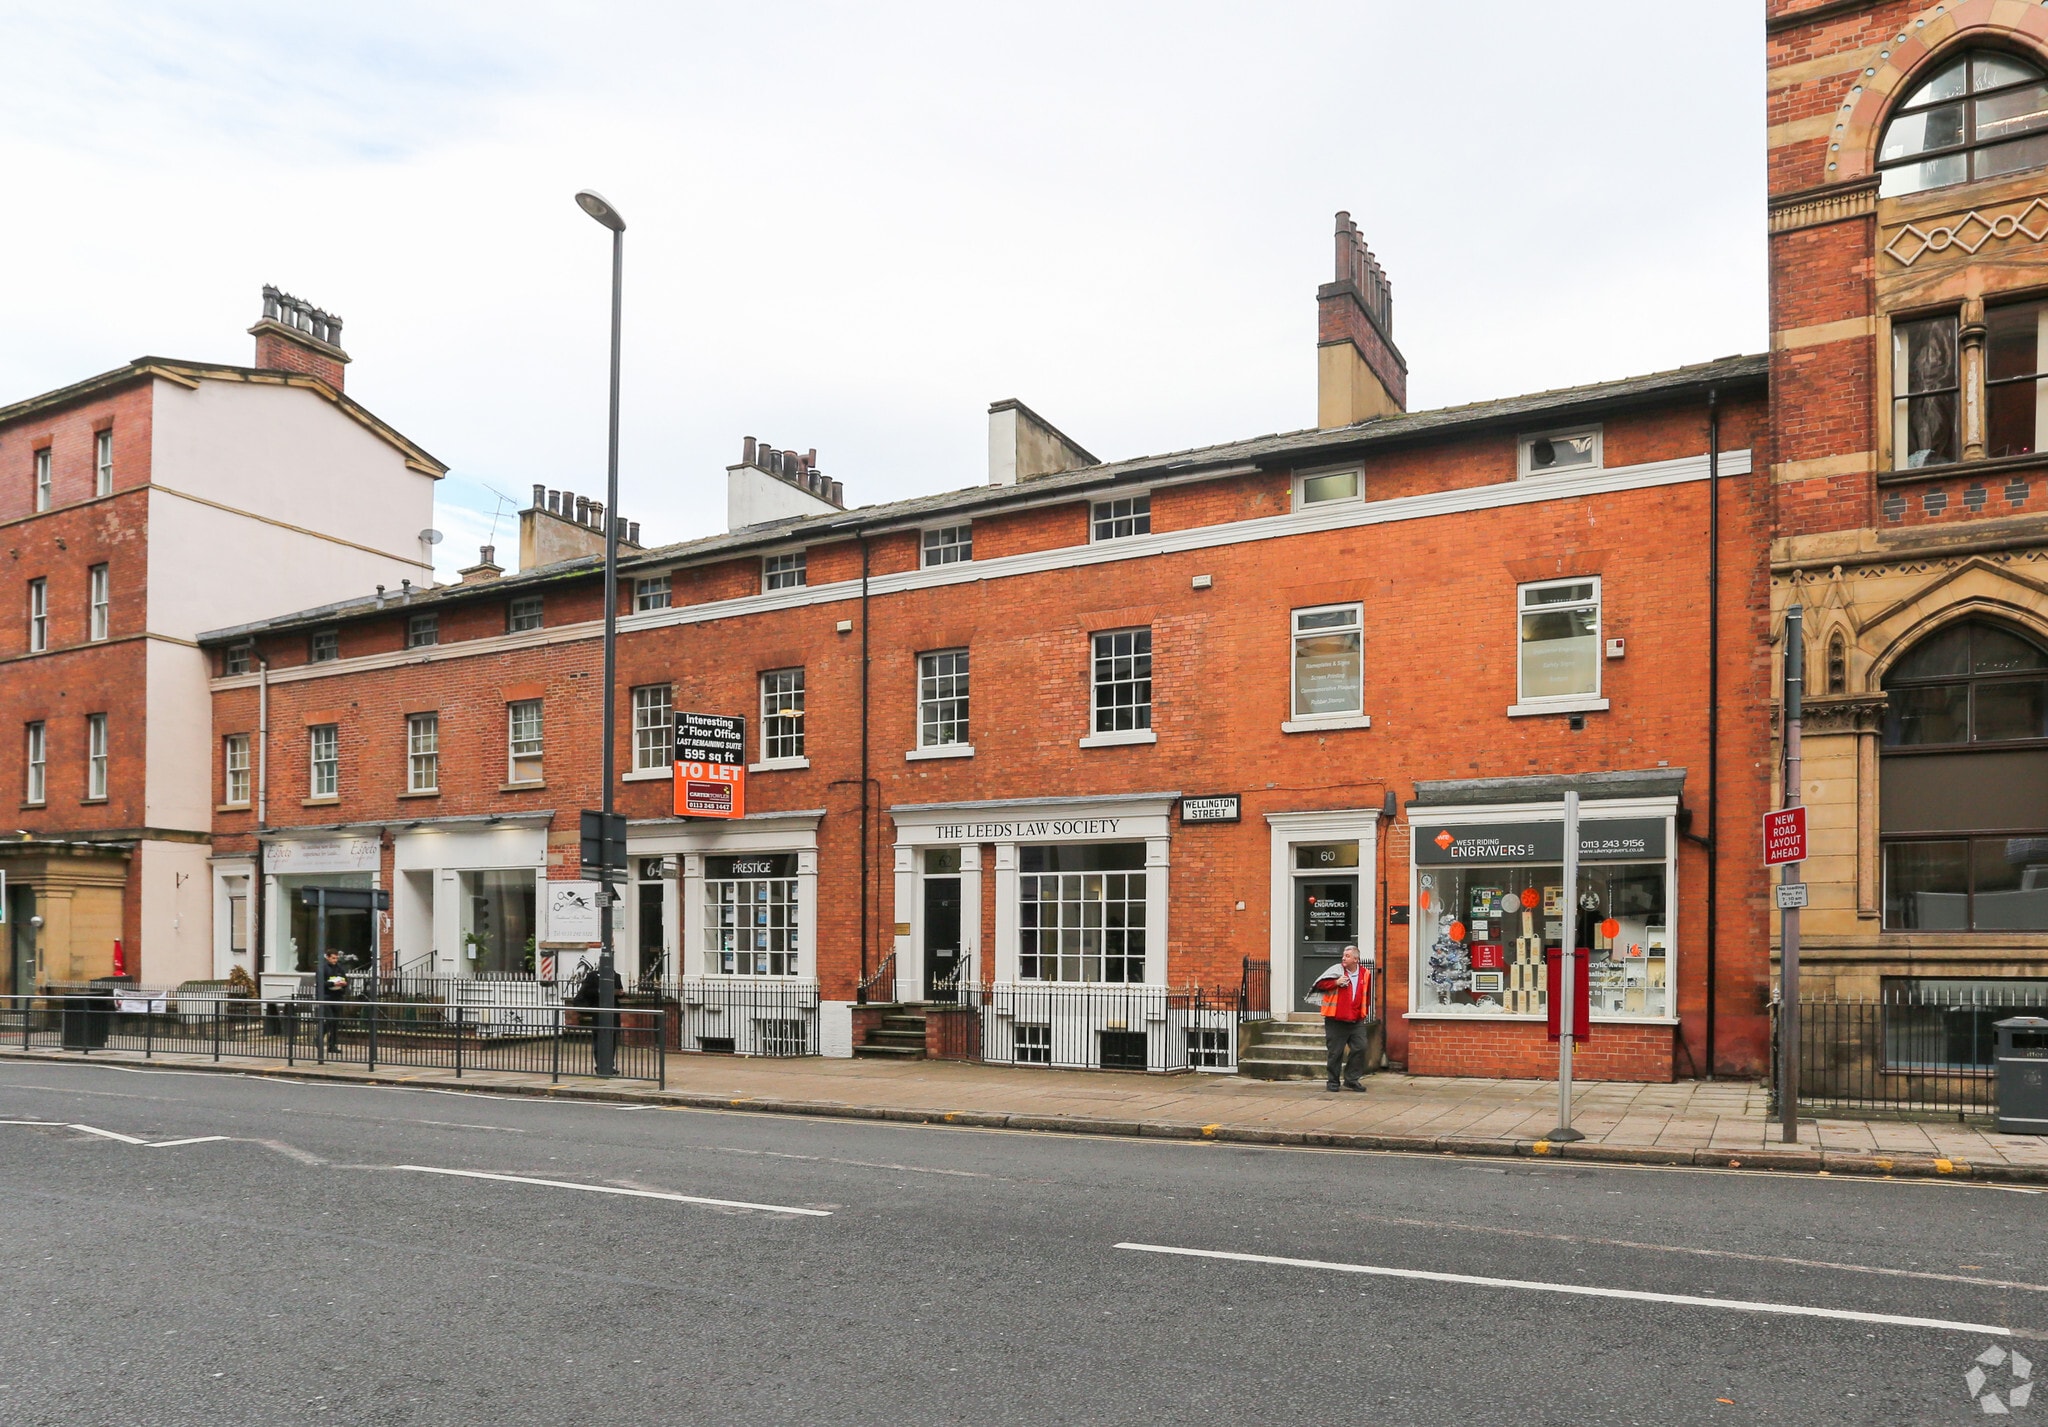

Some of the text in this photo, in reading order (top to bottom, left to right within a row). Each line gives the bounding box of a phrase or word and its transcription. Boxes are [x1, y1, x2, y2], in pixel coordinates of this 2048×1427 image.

[686, 714, 734, 729] Interesting
[689, 726, 712, 737] Floor
[714, 728, 741, 740] Office
[692, 739, 725, 748] REMAINING
[725, 741, 742, 750] SUITE
[685, 749, 735, 763] 595 sq ft
[678, 762, 742, 781] TO LET
[1185, 799, 1235, 808] WELLINGTON
[1192, 809, 1227, 818] STREET
[1775, 814, 1795, 826] NEW
[936, 819, 1120, 838] THE LEEDS LAW SOCIETY
[1773, 825, 1797, 837] ROAD
[1581, 839, 1645, 848] 0113 243 9156
[1770, 835, 1801, 849] LAYOUT
[1320, 851, 1336, 861] 60
[1451, 844, 1525, 857] ENGRAVERS
[1771, 847, 1800, 860] AHEAD
[647, 862, 663, 876] 64
[732, 861, 771, 873] PRESTIGE
